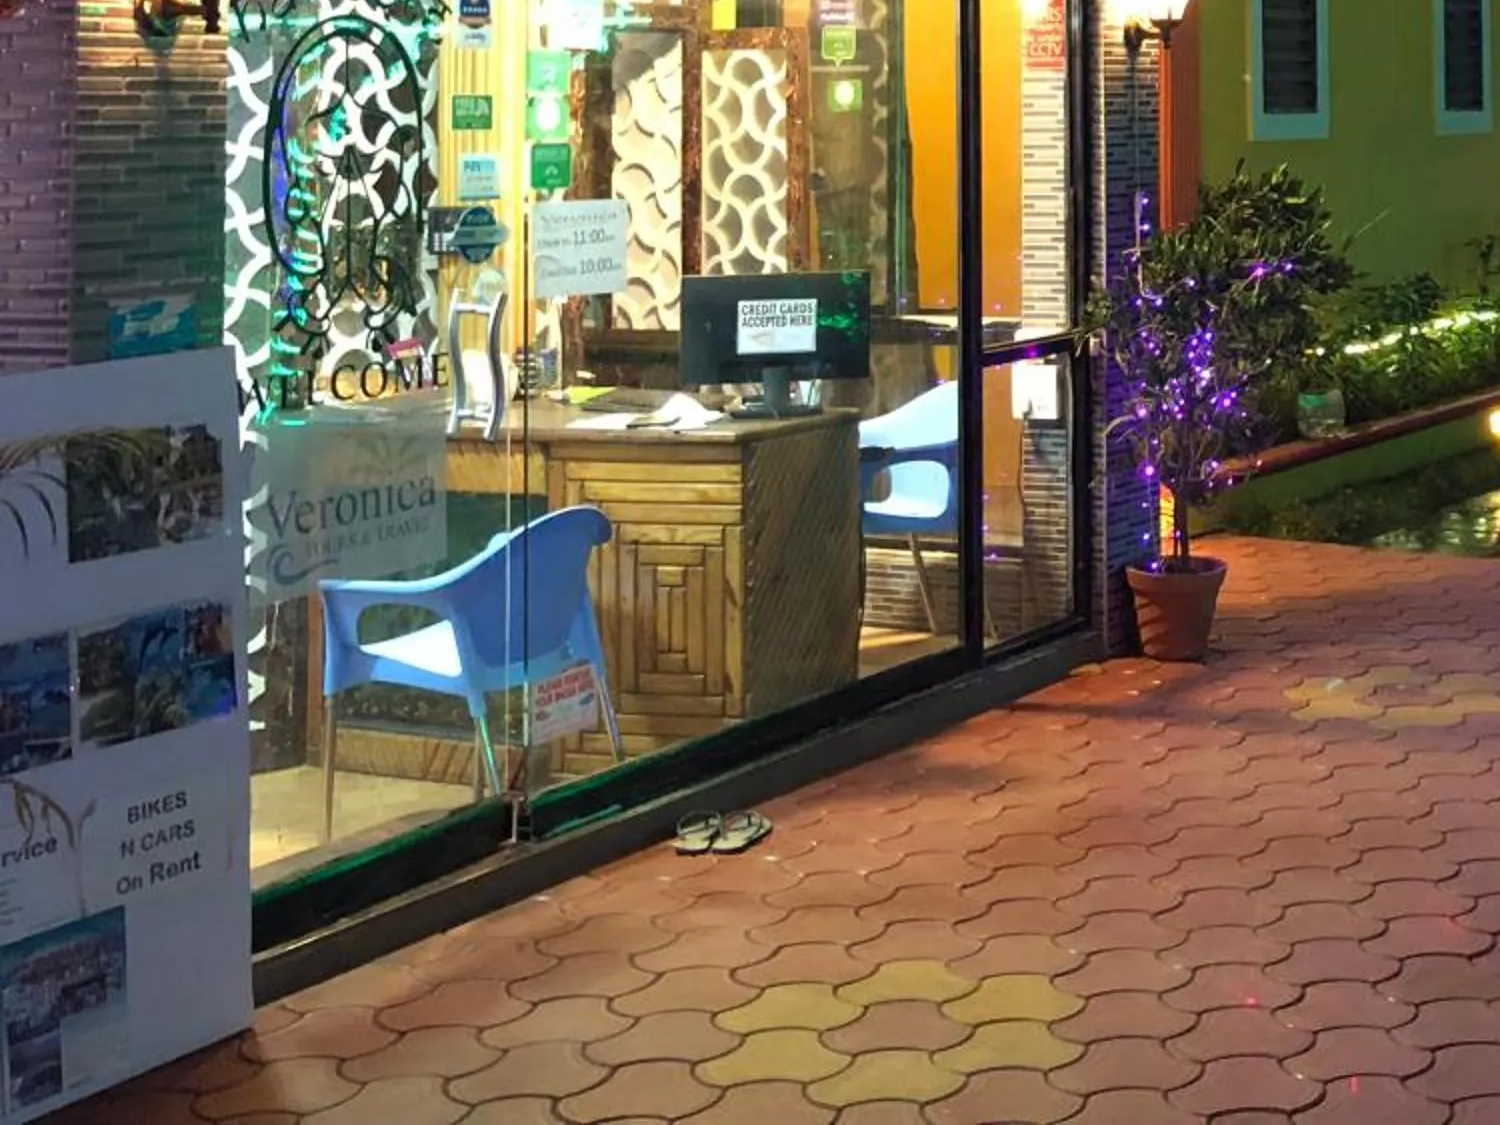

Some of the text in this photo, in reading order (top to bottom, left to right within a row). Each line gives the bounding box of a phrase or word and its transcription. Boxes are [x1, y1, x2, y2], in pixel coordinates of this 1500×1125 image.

[1028, 41, 1063, 57] CCTV
[741, 302, 813, 316] CREDIT CARDS
[741, 314, 813, 328] ACCEPTED HERE
[236, 353, 449, 415] WELCOME
[268, 475, 436, 539] Veronica
[127, 790, 189, 824] BIKES
[120, 819, 195, 859] N CARS
[116, 851, 202, 895] On Rent
